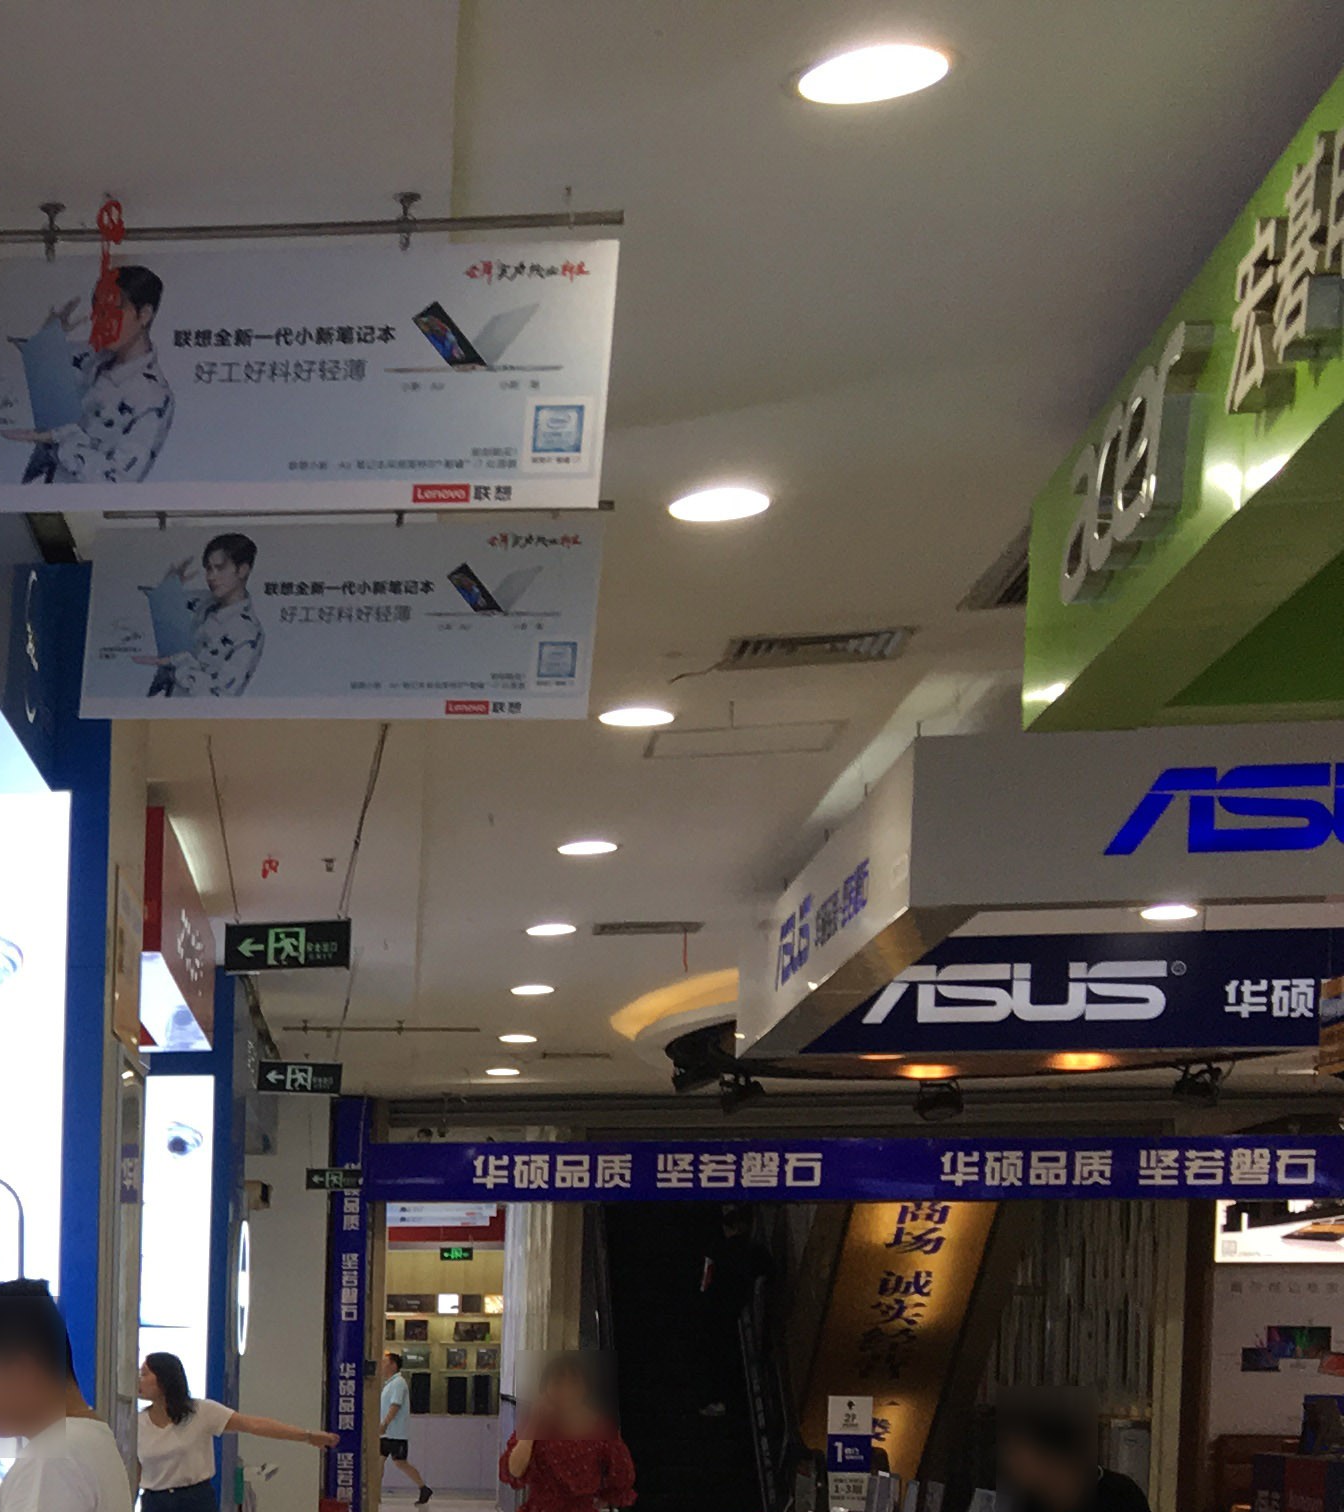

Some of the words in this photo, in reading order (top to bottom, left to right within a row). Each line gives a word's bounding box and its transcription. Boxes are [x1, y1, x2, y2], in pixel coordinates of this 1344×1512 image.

[173, 325, 397, 349] 联想全新一代小新笔记本
[192, 358, 369, 384] 好工好料好轻薄
[415, 487, 468, 500] Lenovo
[474, 484, 512, 501] 联想
[264, 580, 435, 597] 联想全新一代小新笔记本
[447, 703, 487, 714] Lenovo
[1102, 762, 1344, 857] AS
[861, 959, 1170, 1025] ASUS
[1223, 977, 1330, 1020] 华硕
[472, 1153, 633, 1190] 华硕品质
[656, 1151, 823, 1189] 坚若磐石
[939, 1149, 1113, 1187] 华硕品质
[1137, 1147, 1318, 1186] 坚若磐石
